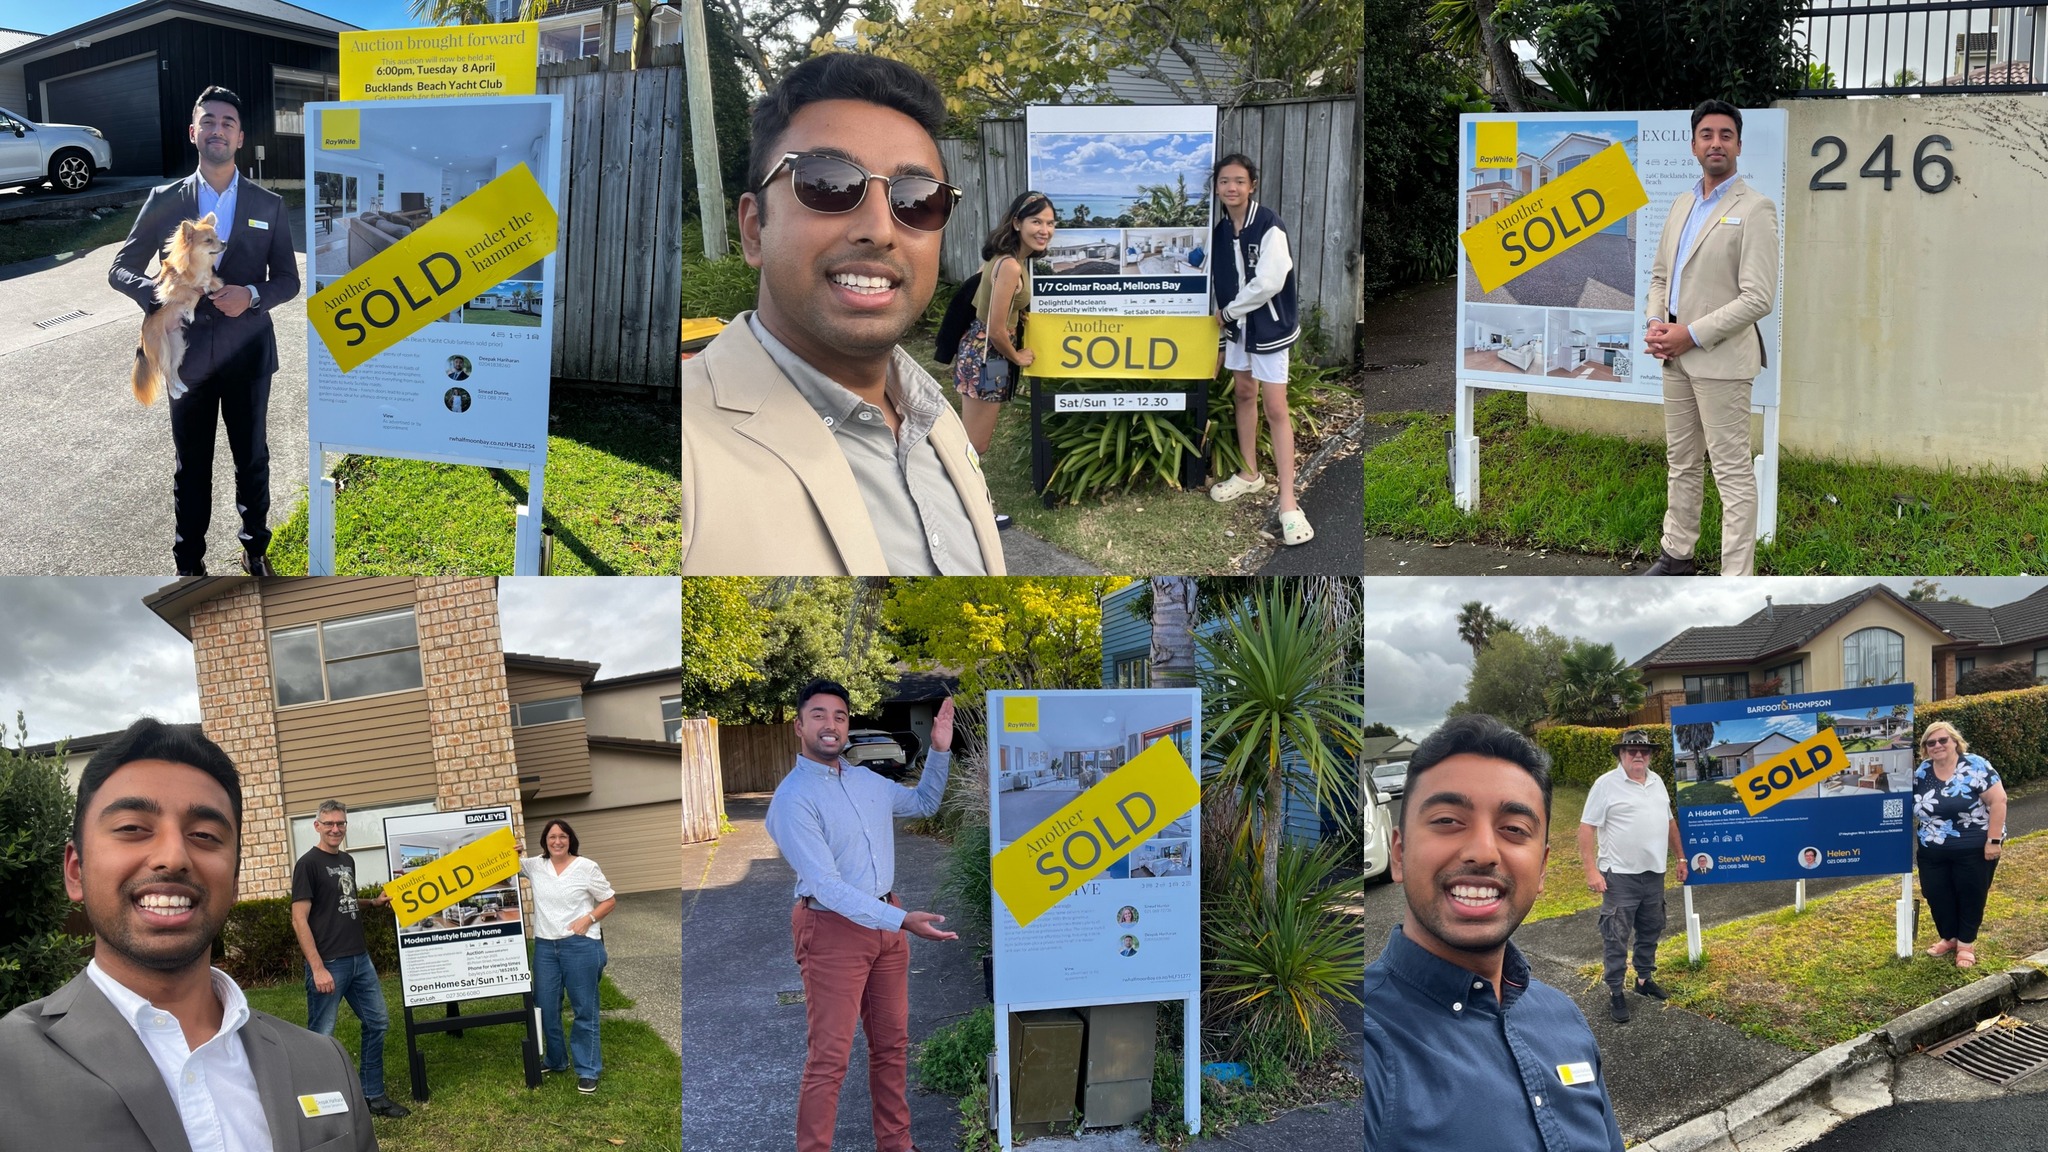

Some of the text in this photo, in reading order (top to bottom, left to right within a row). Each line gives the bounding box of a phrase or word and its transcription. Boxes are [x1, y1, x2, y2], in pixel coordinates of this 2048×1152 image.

[350, 30, 526, 52] Auction brought forward
[376, 62, 496, 76] 6:00pm, Tuesday 8 April
[381, 58, 396, 66] This
[398, 56, 424, 65] auction
[468, 54, 483, 62] held
[365, 79, 502, 92] Bucklands Beach Yacht Club
[325, 138, 356, 146] RayWhite
[1642, 130, 1690, 142] EXCLU
[1810, 134, 1954, 194] 246
[1495, 198, 1544, 234] Another
[464, 210, 534, 258] under the
[1501, 188, 1605, 266] SOLD
[471, 230, 533, 274] hammer
[322, 276, 372, 312] Another
[1038, 281, 1181, 292] 1/7 Colmar Road, Mellons Bay
[334, 252, 462, 346] SOLD
[1063, 320, 1124, 333] Another
[1060, 335, 1178, 370] SOLD
[1059, 397, 1106, 409] Sat/Sun
[1113, 397, 1124, 406] 12
[1748, 744, 1833, 801] SOLD
[467, 813, 505, 823] BAYLEYS
[1026, 808, 1084, 858] Another
[1036, 792, 1156, 891] SOLD
[476, 850, 511, 871] under the
[1741, 854, 1766, 863] Weng
[480, 860, 511, 879] hammer
[396, 873, 426, 892] Another
[401, 865, 474, 913] SOLD
[432, 932, 459, 941] lifestyle
[460, 930, 481, 939] family
[410, 984, 434, 993] Open
[435, 981, 460, 989] Home
[460, 977, 494, 987] Sat/Sun
[511, 973, 530, 982] 11.30
